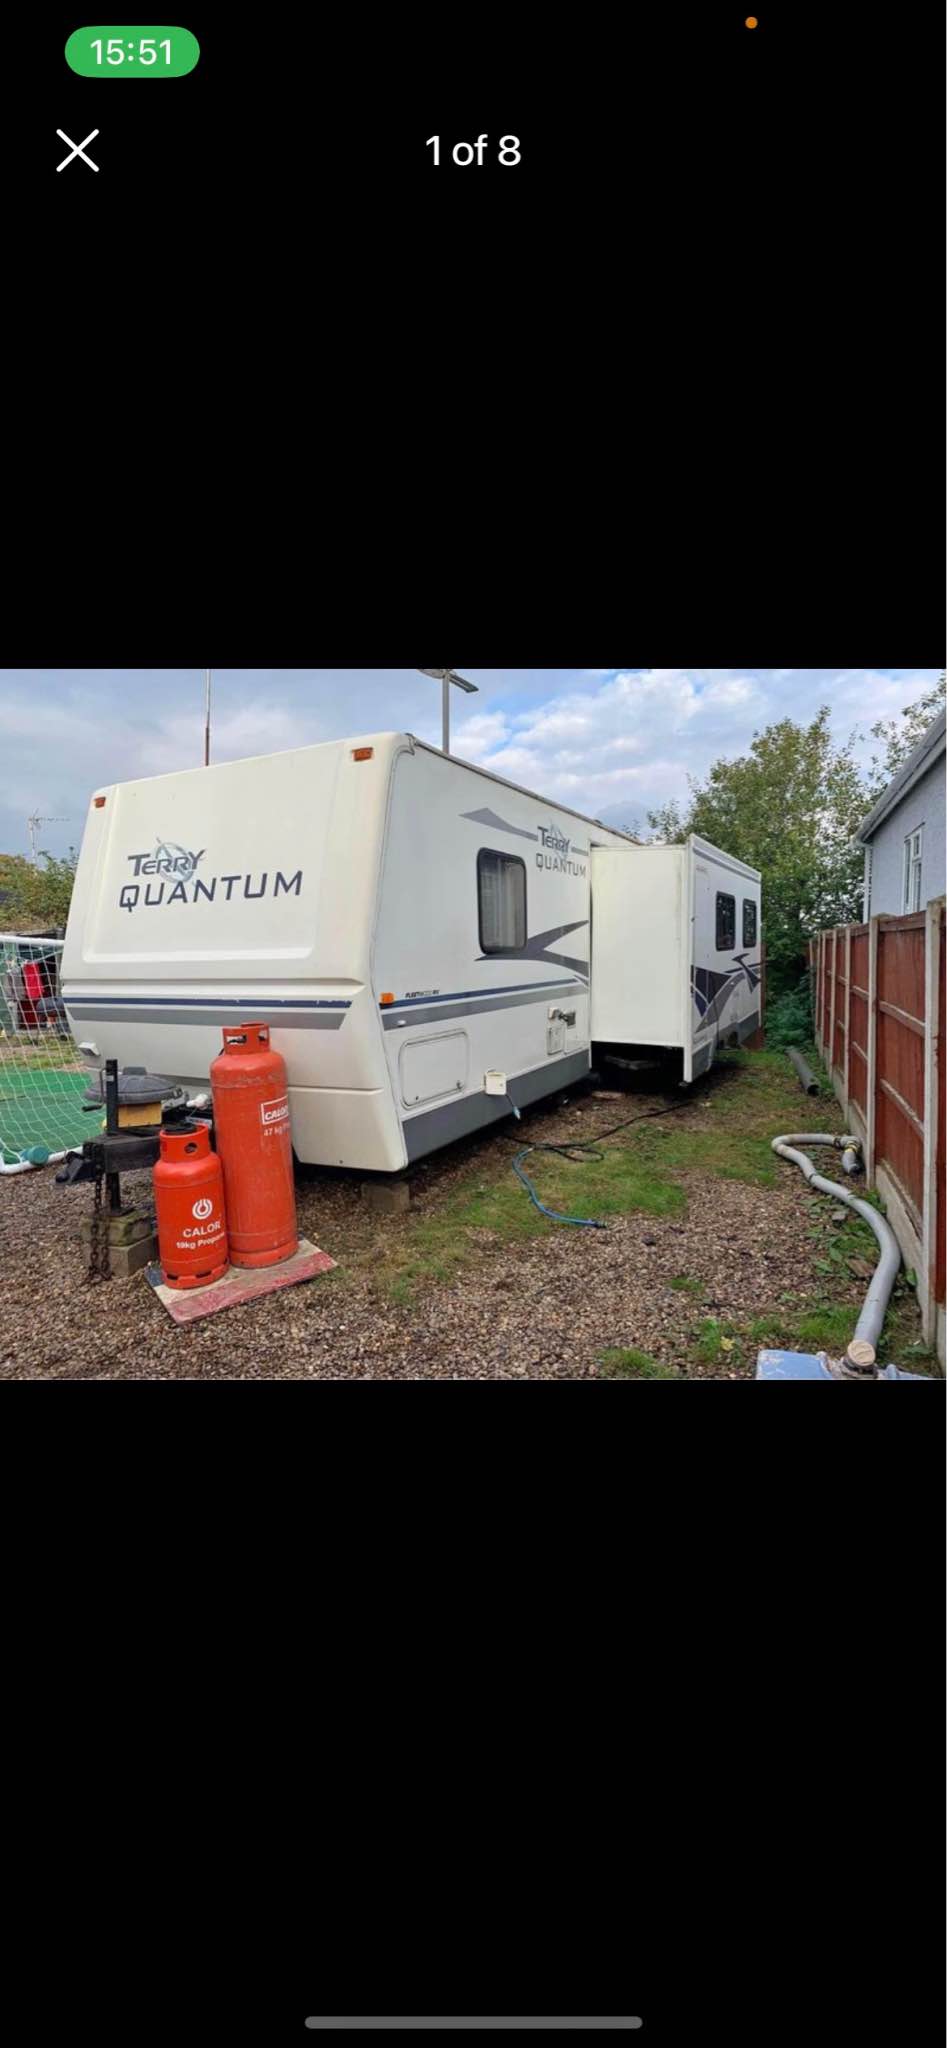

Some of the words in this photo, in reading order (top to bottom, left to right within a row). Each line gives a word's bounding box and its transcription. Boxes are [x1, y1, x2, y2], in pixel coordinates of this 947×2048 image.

[127, 848, 206, 877] TERRY
[536, 852, 587, 878] QUANTUM
[119, 870, 303, 913] QUANTUM
[183, 1220, 221, 1238] CALOR
